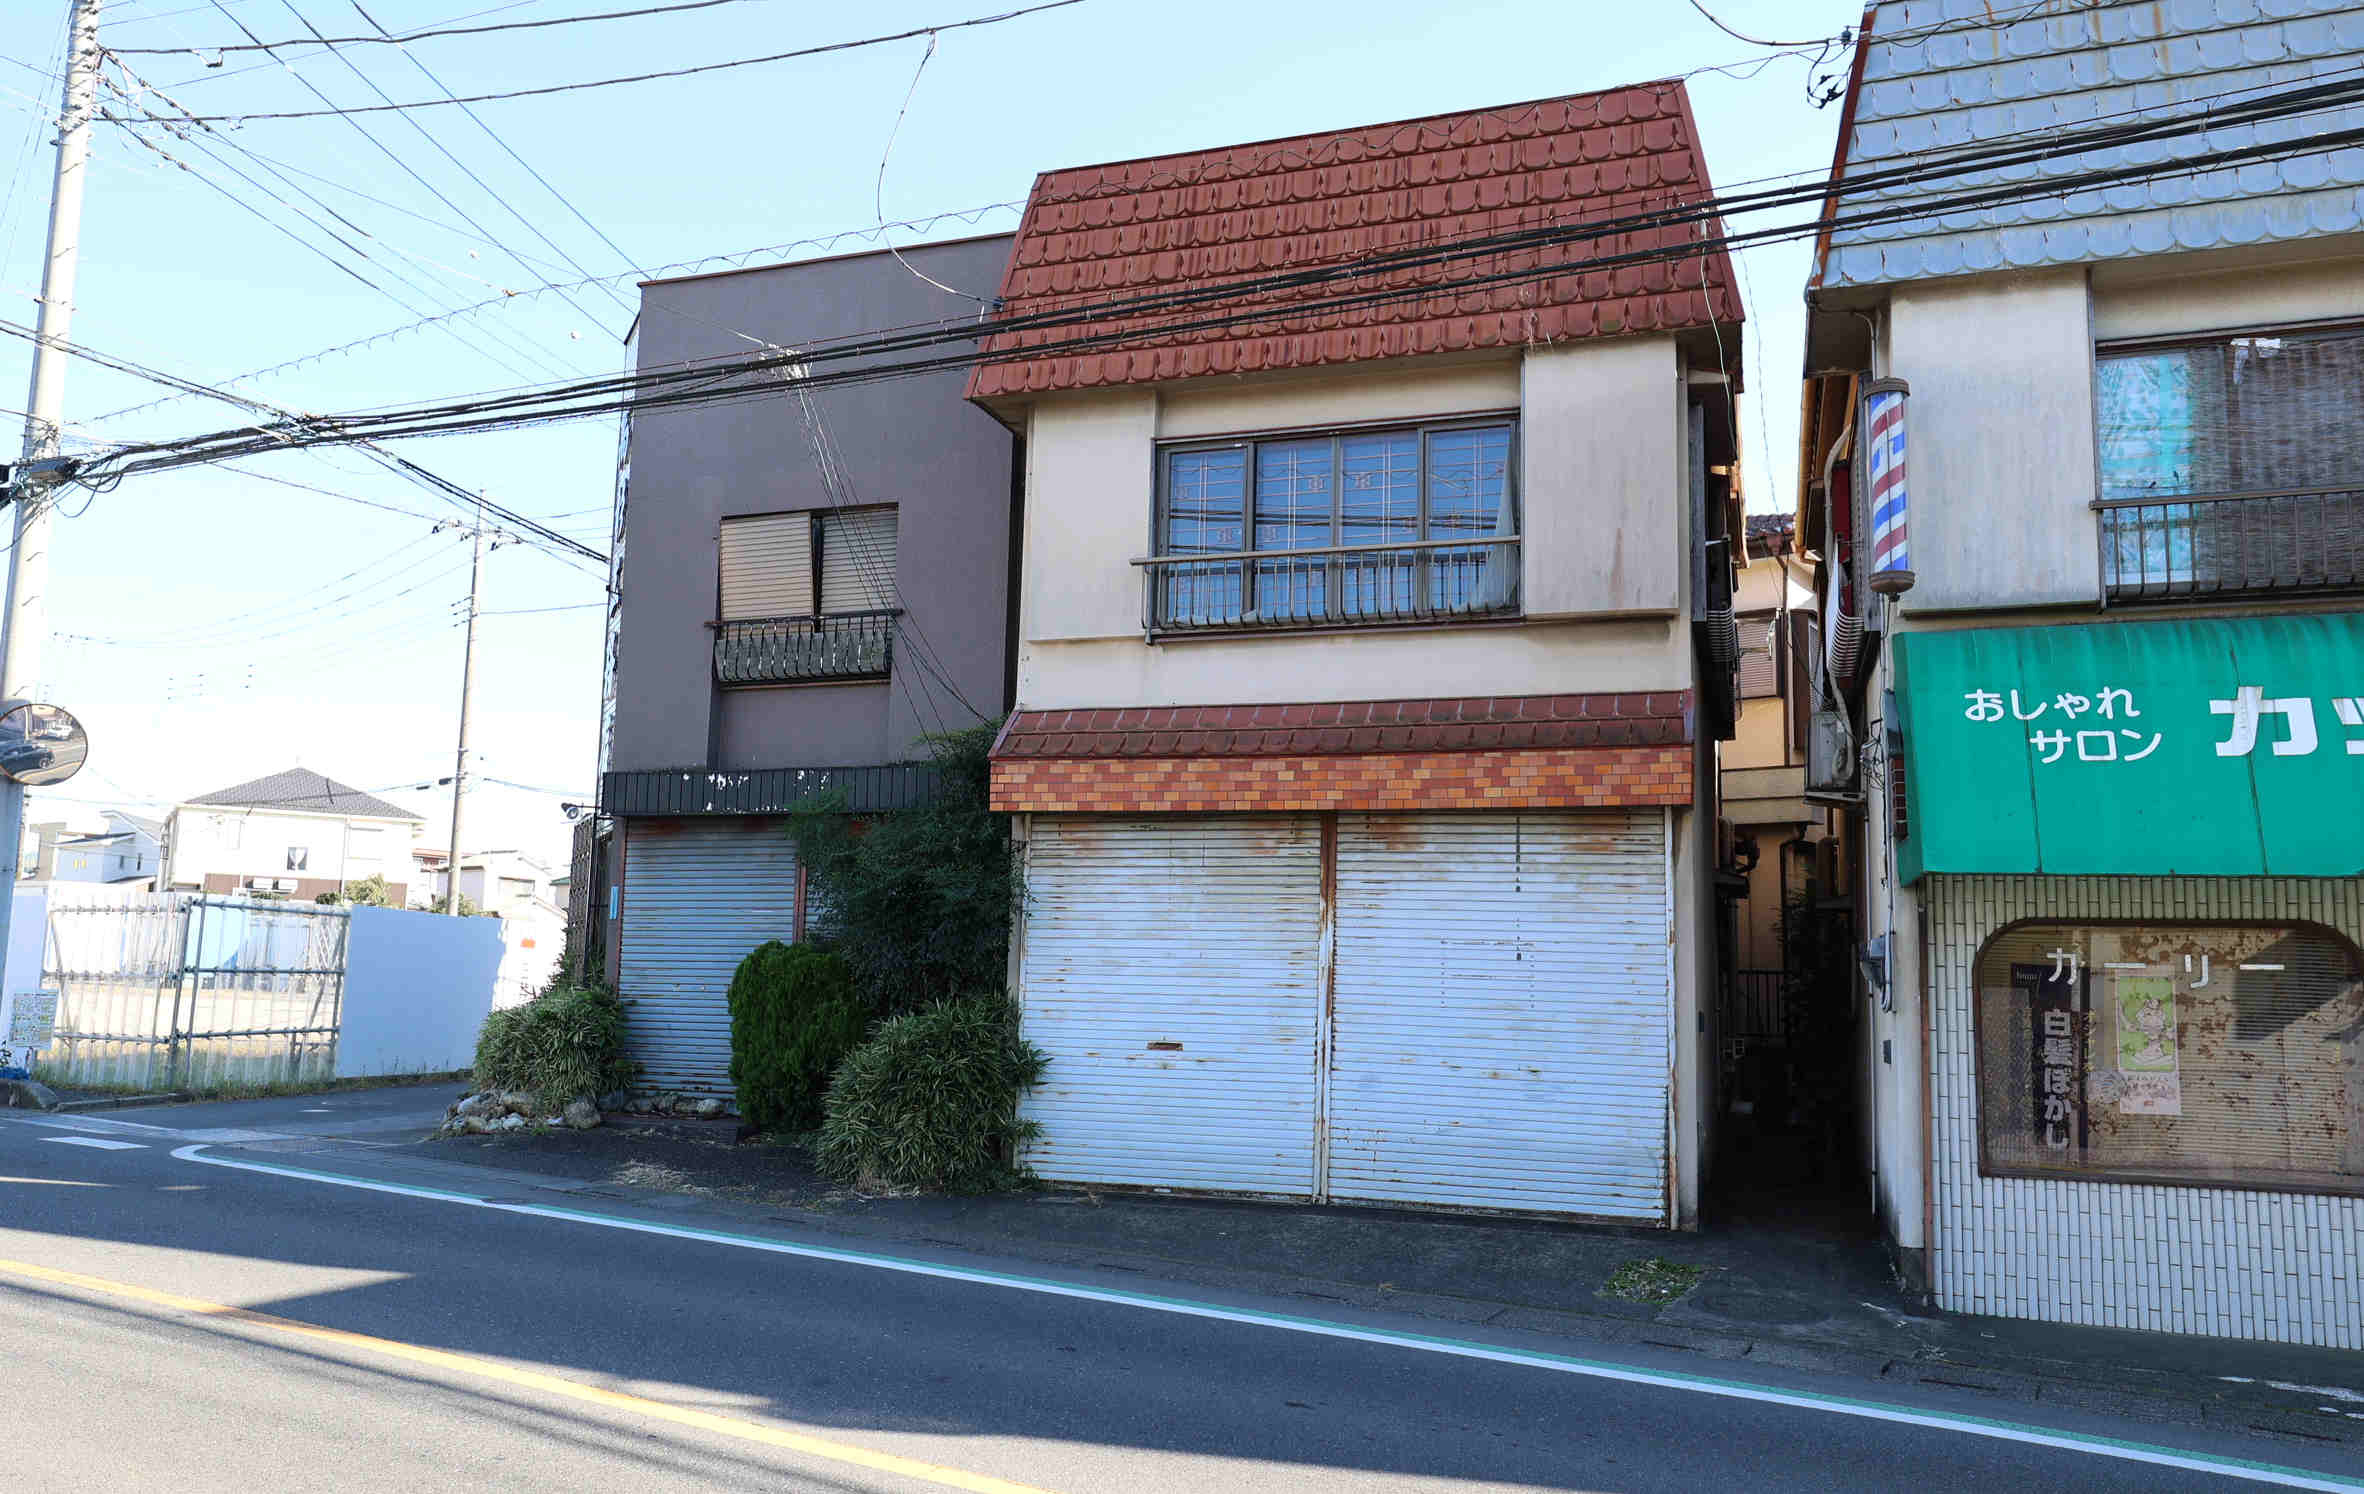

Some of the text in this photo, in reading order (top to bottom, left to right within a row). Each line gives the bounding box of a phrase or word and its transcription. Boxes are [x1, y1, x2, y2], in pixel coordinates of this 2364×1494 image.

[1964, 686, 2141, 722] おしゃれ
[2029, 728, 2162, 764] サロン
[2047, 947, 2285, 986] カーリー
